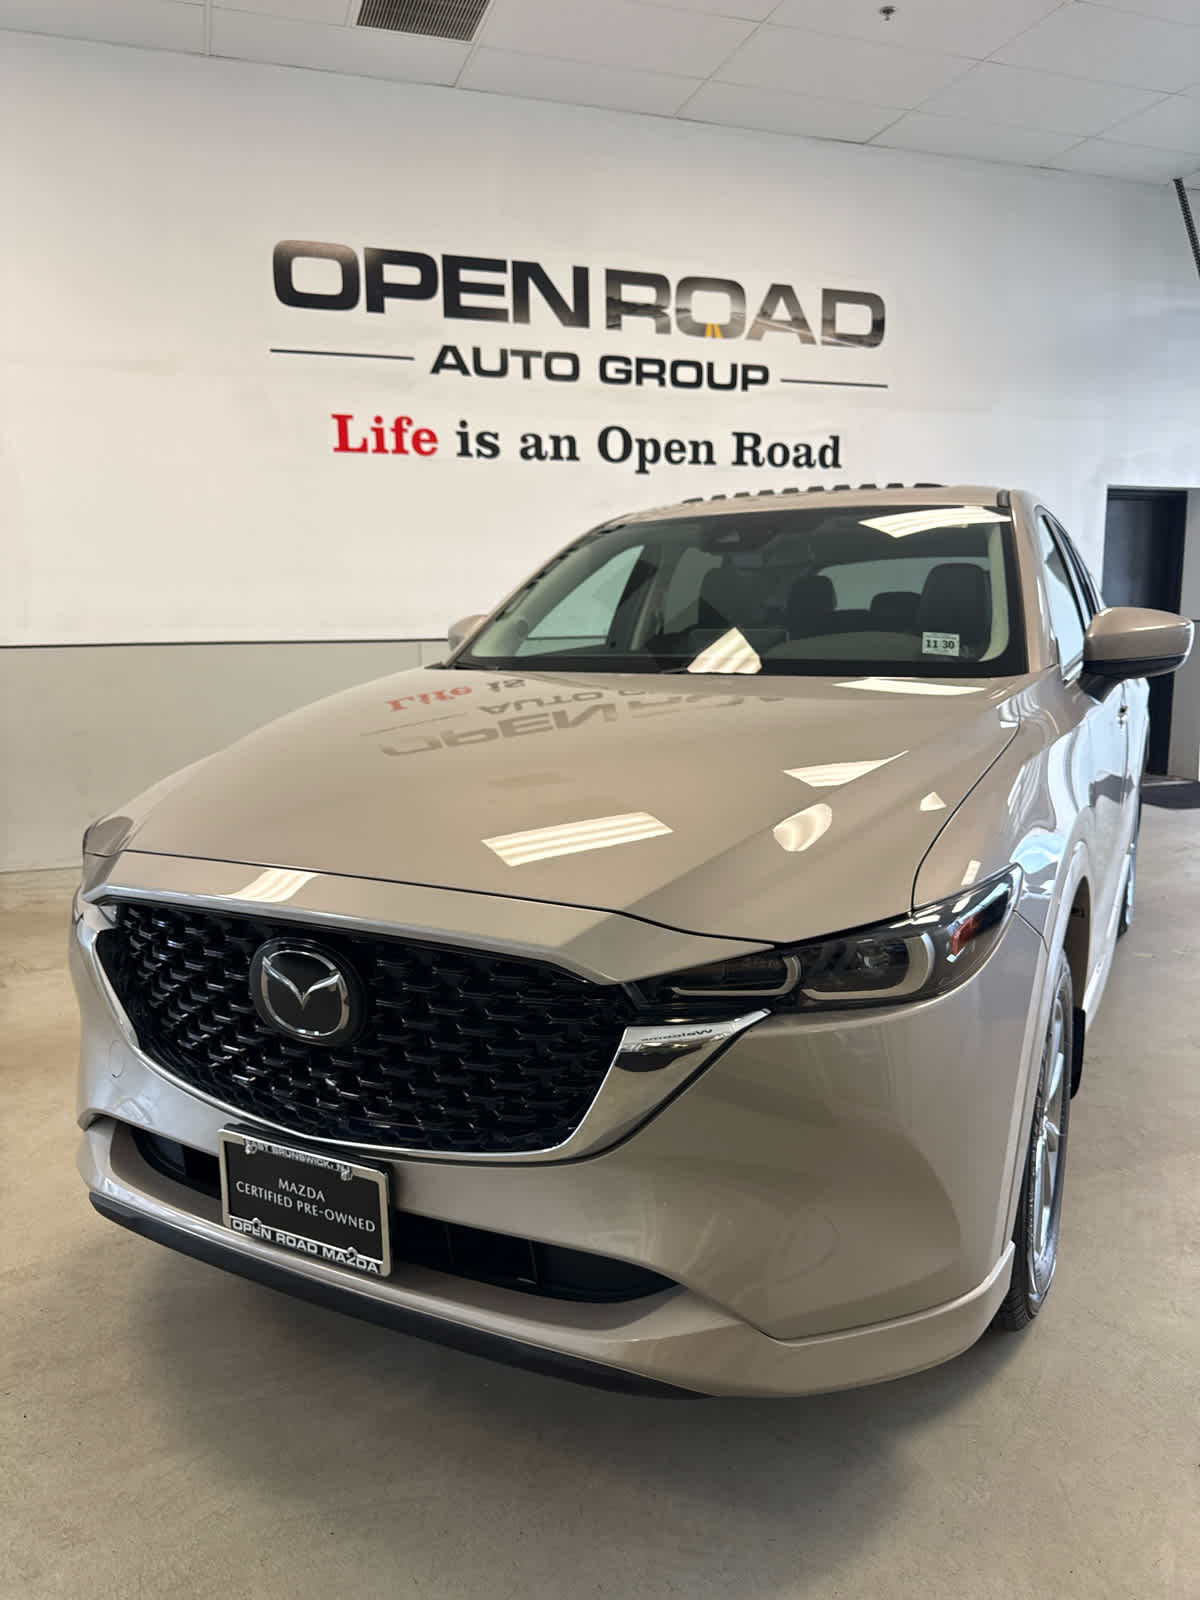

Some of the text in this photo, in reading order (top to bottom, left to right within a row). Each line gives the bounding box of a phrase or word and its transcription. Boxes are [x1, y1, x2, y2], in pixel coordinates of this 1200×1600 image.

[273, 239, 887, 349] OPEN ROAD
[430, 344, 769, 392] AUTO GROUP
[331, 413, 842, 474] Life is an Open Road
[926, 639, 955, 650] 11 30
[236, 1181, 376, 1232] CERTIFIED PRE-OWNED
[278, 1178, 326, 1202] MAZDA
[232, 1219, 379, 1273] OPEN ROAD MAZDA
